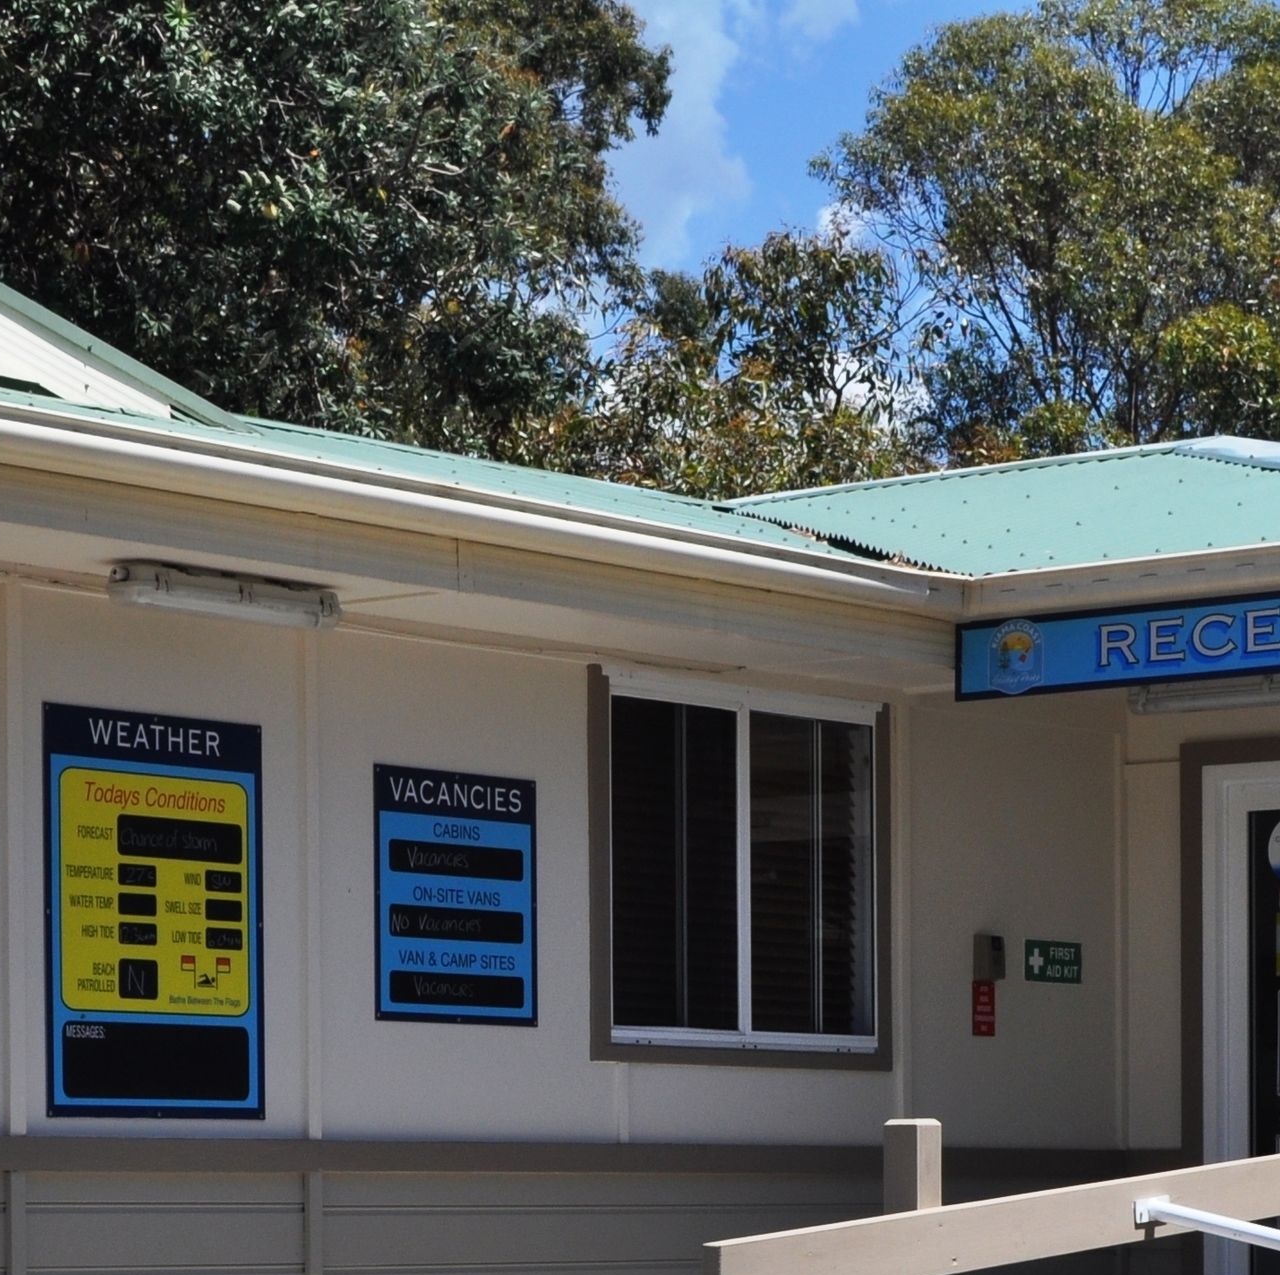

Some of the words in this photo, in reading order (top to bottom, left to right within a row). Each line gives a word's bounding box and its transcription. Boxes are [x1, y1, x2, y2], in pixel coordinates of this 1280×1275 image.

[89, 717, 221, 757] WEATHER
[84, 781, 140, 812] Todays
[145, 787, 226, 814] Conditions
[389, 777, 522, 813] VACANCIES
[77, 825, 114, 841] FORECAST
[433, 823, 481, 841] CABINS
[65, 864, 114, 881] TEMPERATURE
[184, 872, 202, 886] WIND
[69, 895, 94, 909] WATER
[413, 886, 464, 905] ON-SITE
[467, 890, 501, 907] VANS
[165, 902, 187, 915] SWELL
[189, 903, 202, 916] SIZE
[81, 924, 98, 938] HIGH
[99, 925, 115, 939] TIDE
[171, 930, 187, 944] LOW
[188, 931, 202, 944] TIDE
[399, 950, 424, 966] VAN
[429, 952, 437, 967] &
[440, 952, 477, 969] CAMP
[480, 955, 516, 971] SITES
[1049, 947, 1075, 960] FIRST
[92, 964, 115, 976] BEACH
[1046, 966, 1062, 978] AID
[1063, 966, 1079, 979] KIT
[77, 979, 115, 993] PATROLLED
[128, 964, 146, 996] N
